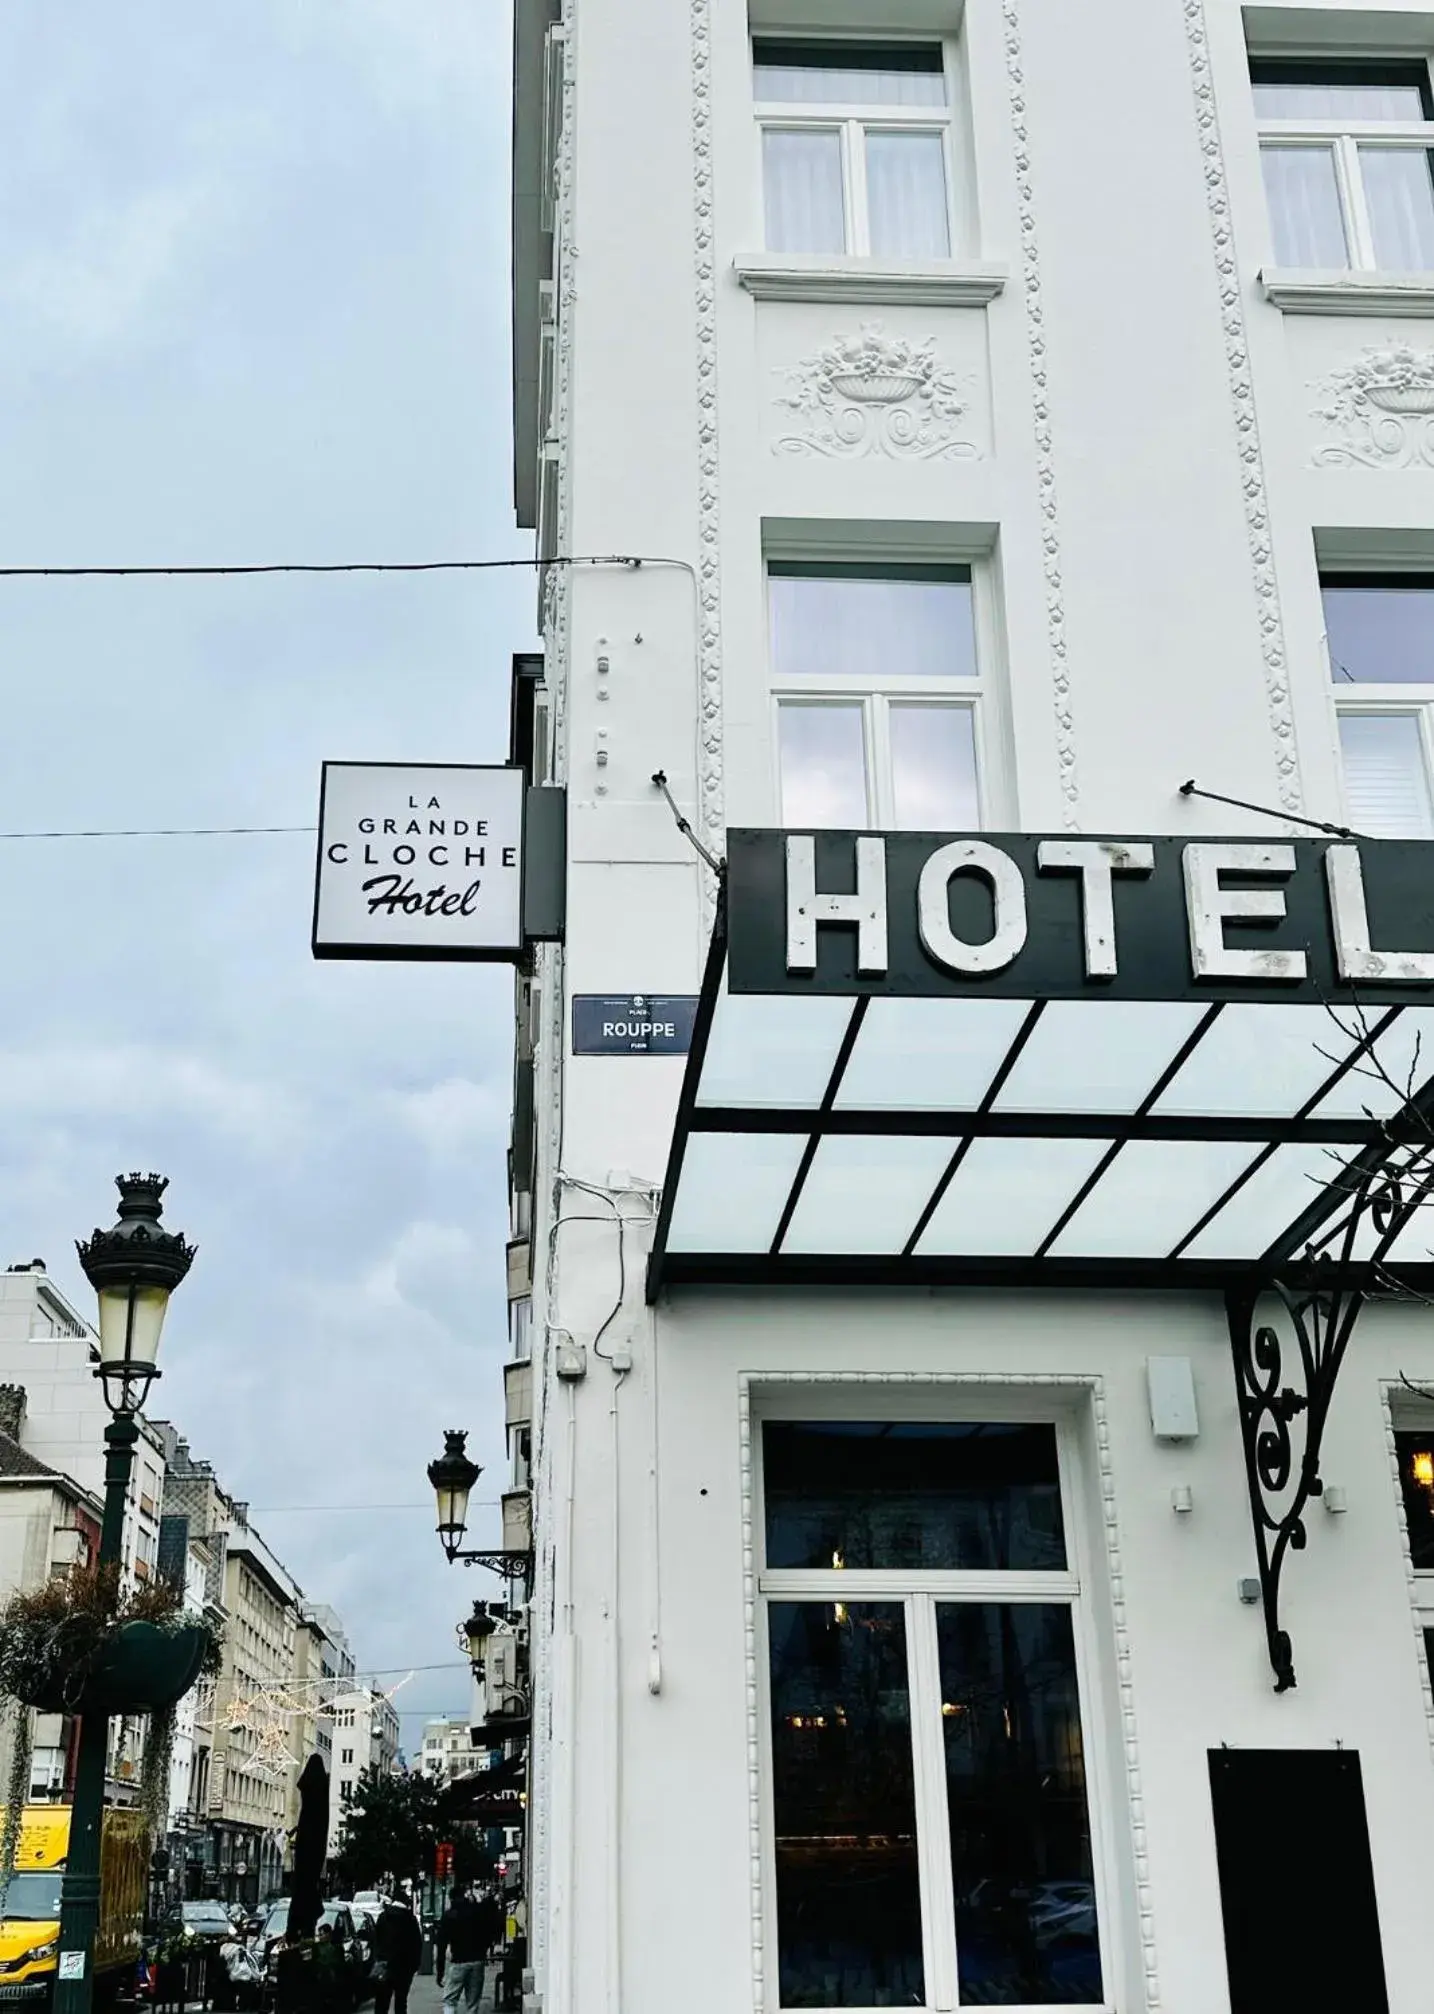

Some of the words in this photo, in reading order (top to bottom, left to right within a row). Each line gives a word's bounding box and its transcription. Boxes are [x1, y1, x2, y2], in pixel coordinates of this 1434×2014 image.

[408, 795, 440, 809] LA
[358, 818, 489, 836] GRANDE
[327, 843, 517, 867] CLOCHE
[361, 873, 481, 916] Hotel
[785, 834, 1434, 982] HOTEL
[602, 1022, 675, 1037] ROUPPE
